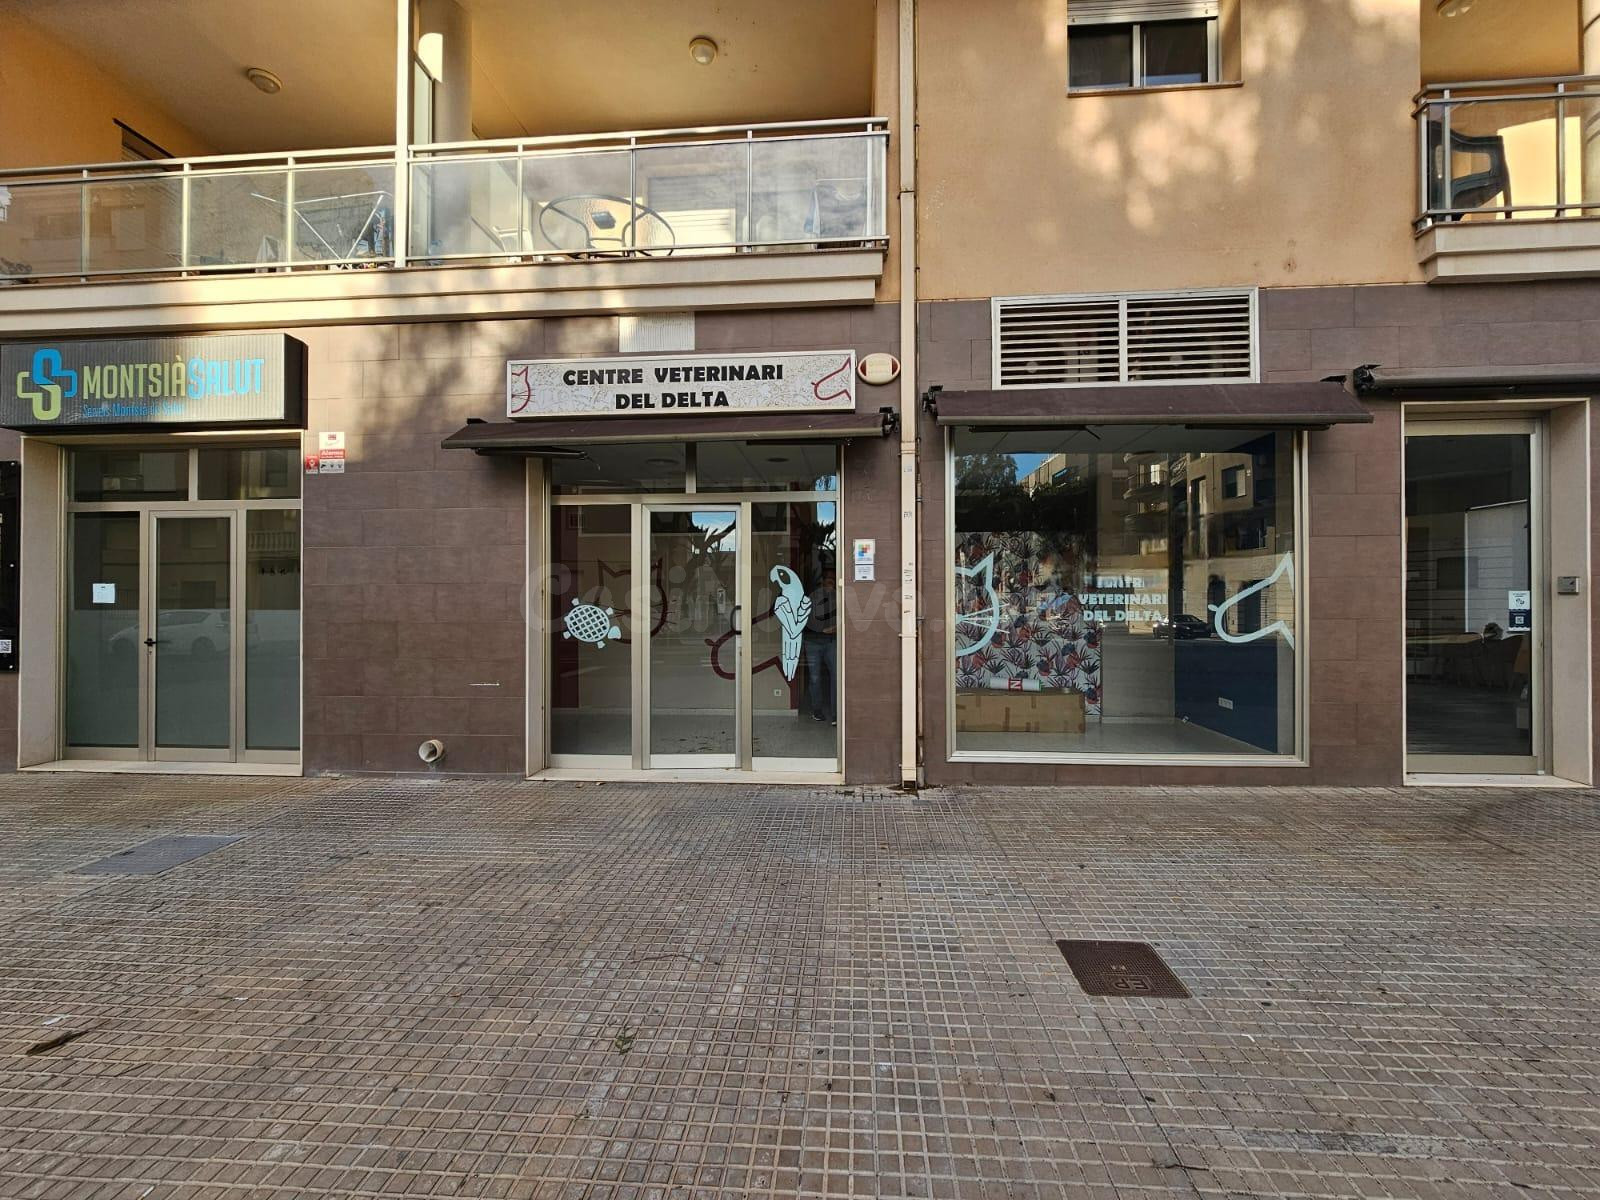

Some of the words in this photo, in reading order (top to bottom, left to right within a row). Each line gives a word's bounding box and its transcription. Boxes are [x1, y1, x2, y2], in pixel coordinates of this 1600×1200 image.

[563, 368, 643, 386] CENTRE
[654, 364, 784, 384] VETERINARI
[615, 393, 656, 410] DEL
[661, 391, 730, 409] DELTA
[1079, 593, 1168, 605] VETERINARI
[1083, 610, 1111, 622] DEL
[1115, 610, 1162, 622] DELTA
